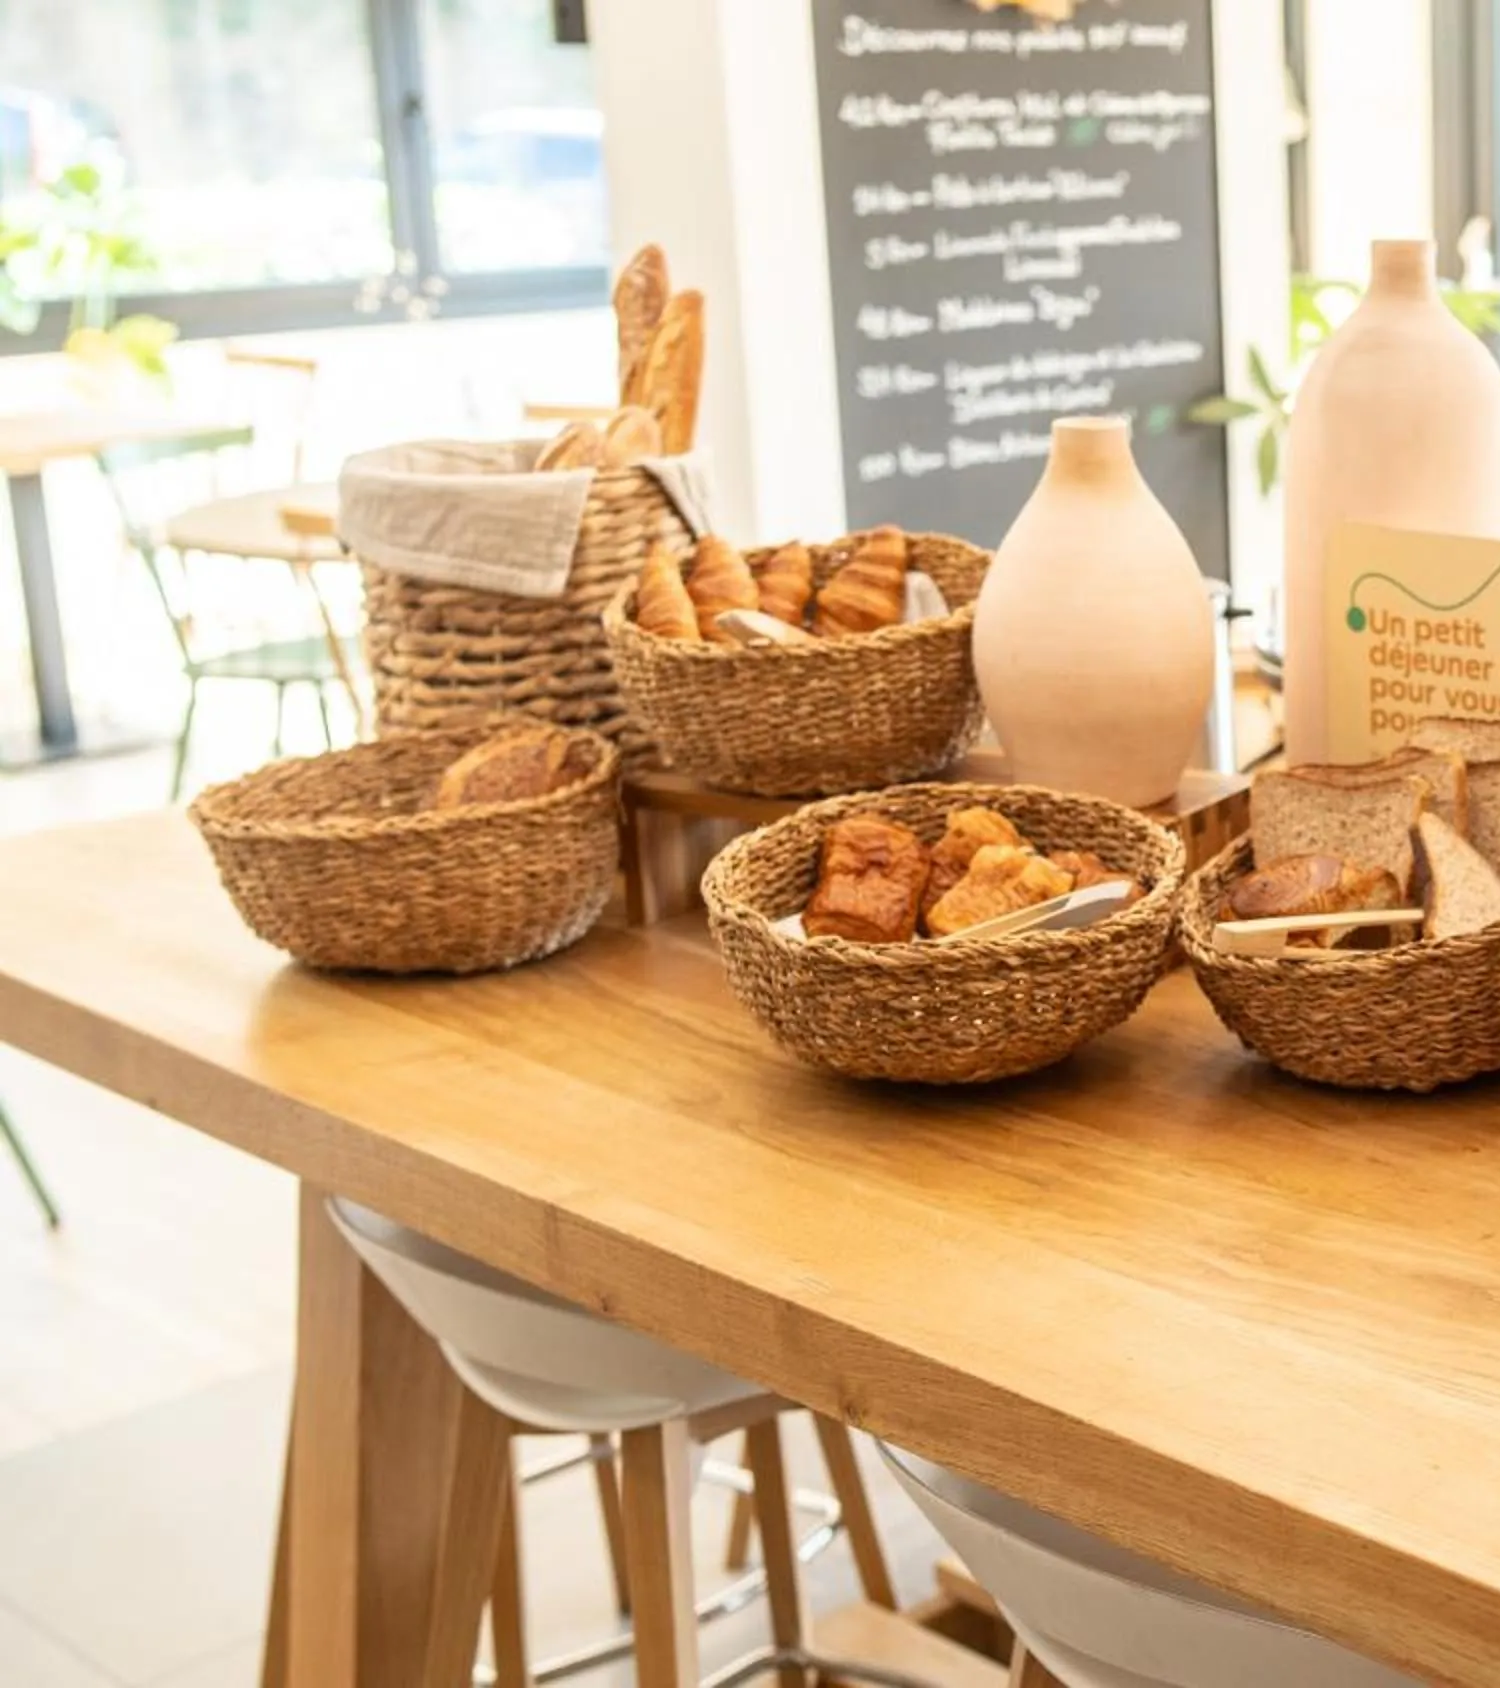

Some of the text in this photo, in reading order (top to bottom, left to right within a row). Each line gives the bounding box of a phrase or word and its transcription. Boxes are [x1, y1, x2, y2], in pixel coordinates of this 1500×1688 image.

[1368, 609, 1485, 649] Un petit
[1368, 643, 1493, 678] déjeuner
[1370, 677, 1436, 705] pour
